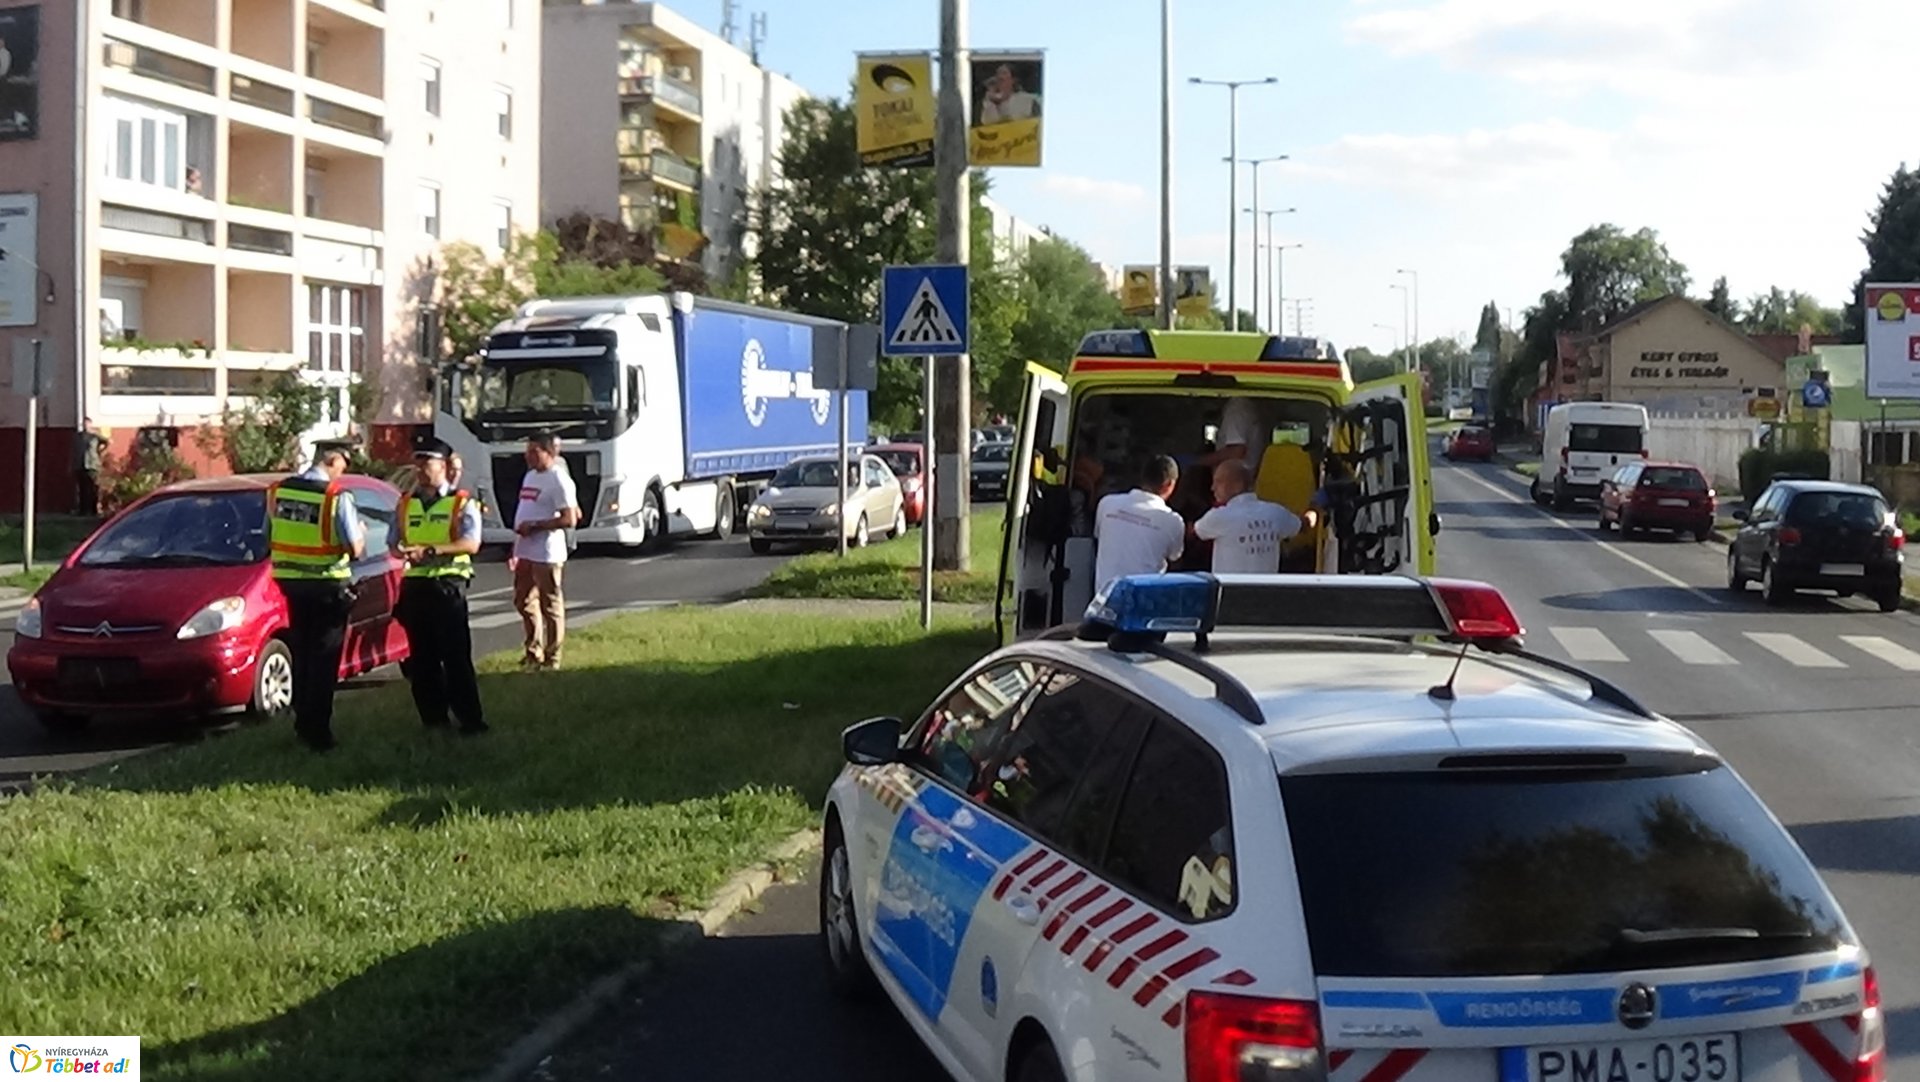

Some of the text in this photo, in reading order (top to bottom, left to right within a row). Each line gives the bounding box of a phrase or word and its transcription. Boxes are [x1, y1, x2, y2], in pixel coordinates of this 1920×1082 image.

[1678, 351, 1719, 363] GYROS
[1466, 996, 1582, 1019] RENDŐRSÉG
[1538, 1039, 1727, 1082] PMA-035
